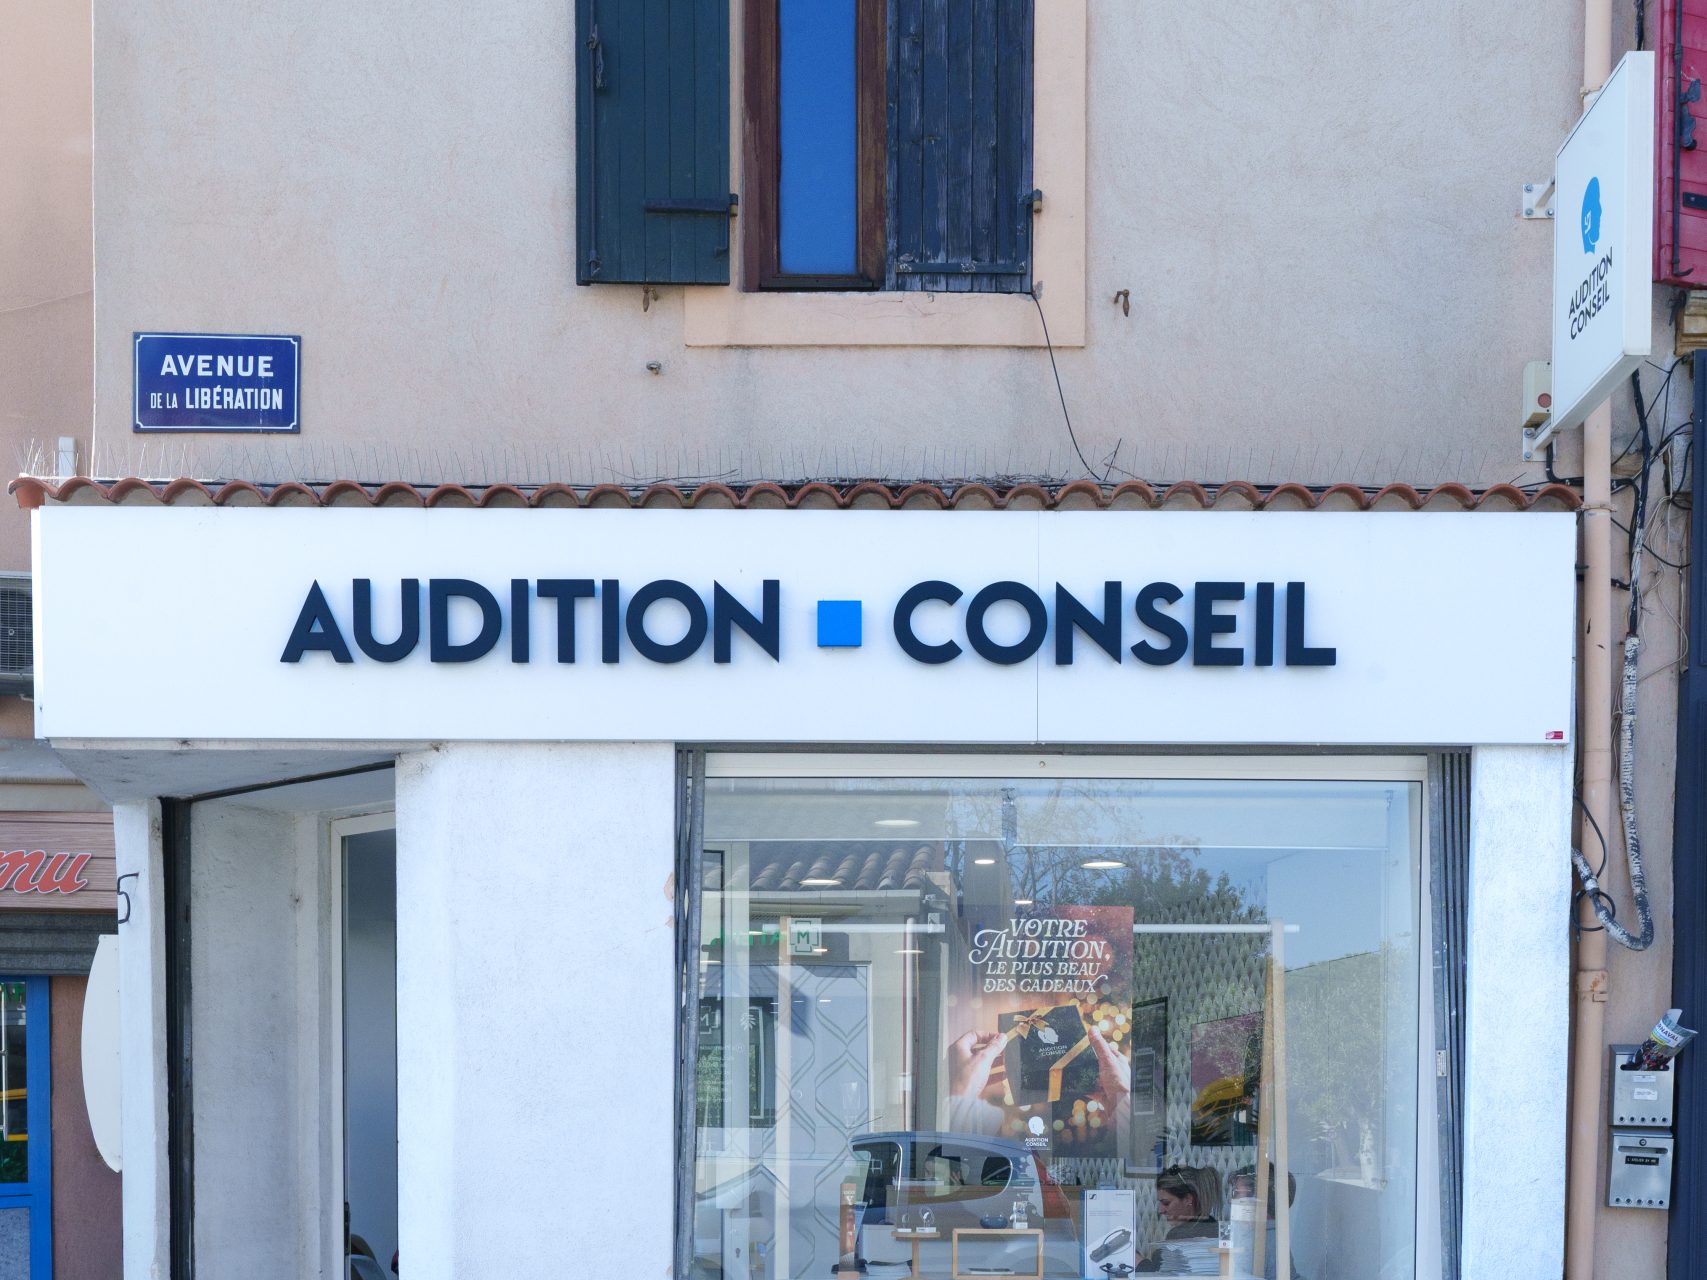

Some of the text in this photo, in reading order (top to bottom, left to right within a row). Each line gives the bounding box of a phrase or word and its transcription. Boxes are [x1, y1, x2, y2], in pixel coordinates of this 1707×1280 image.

[1568, 245, 1613, 319] AUDITION
[1570, 279, 1610, 340] CONSEIL
[160, 354, 274, 377] AVENUE
[150, 384, 283, 410] DE LA LIBÉRATION
[279, 578, 1337, 667] AUDITION CONSEIL
[1009, 918, 1088, 938] VOTRE
[968, 928, 1111, 965] AUDITION,
[985, 961, 1101, 976] LE PLUS BEAU
[983, 974, 1109, 993] DES CADEAUX
